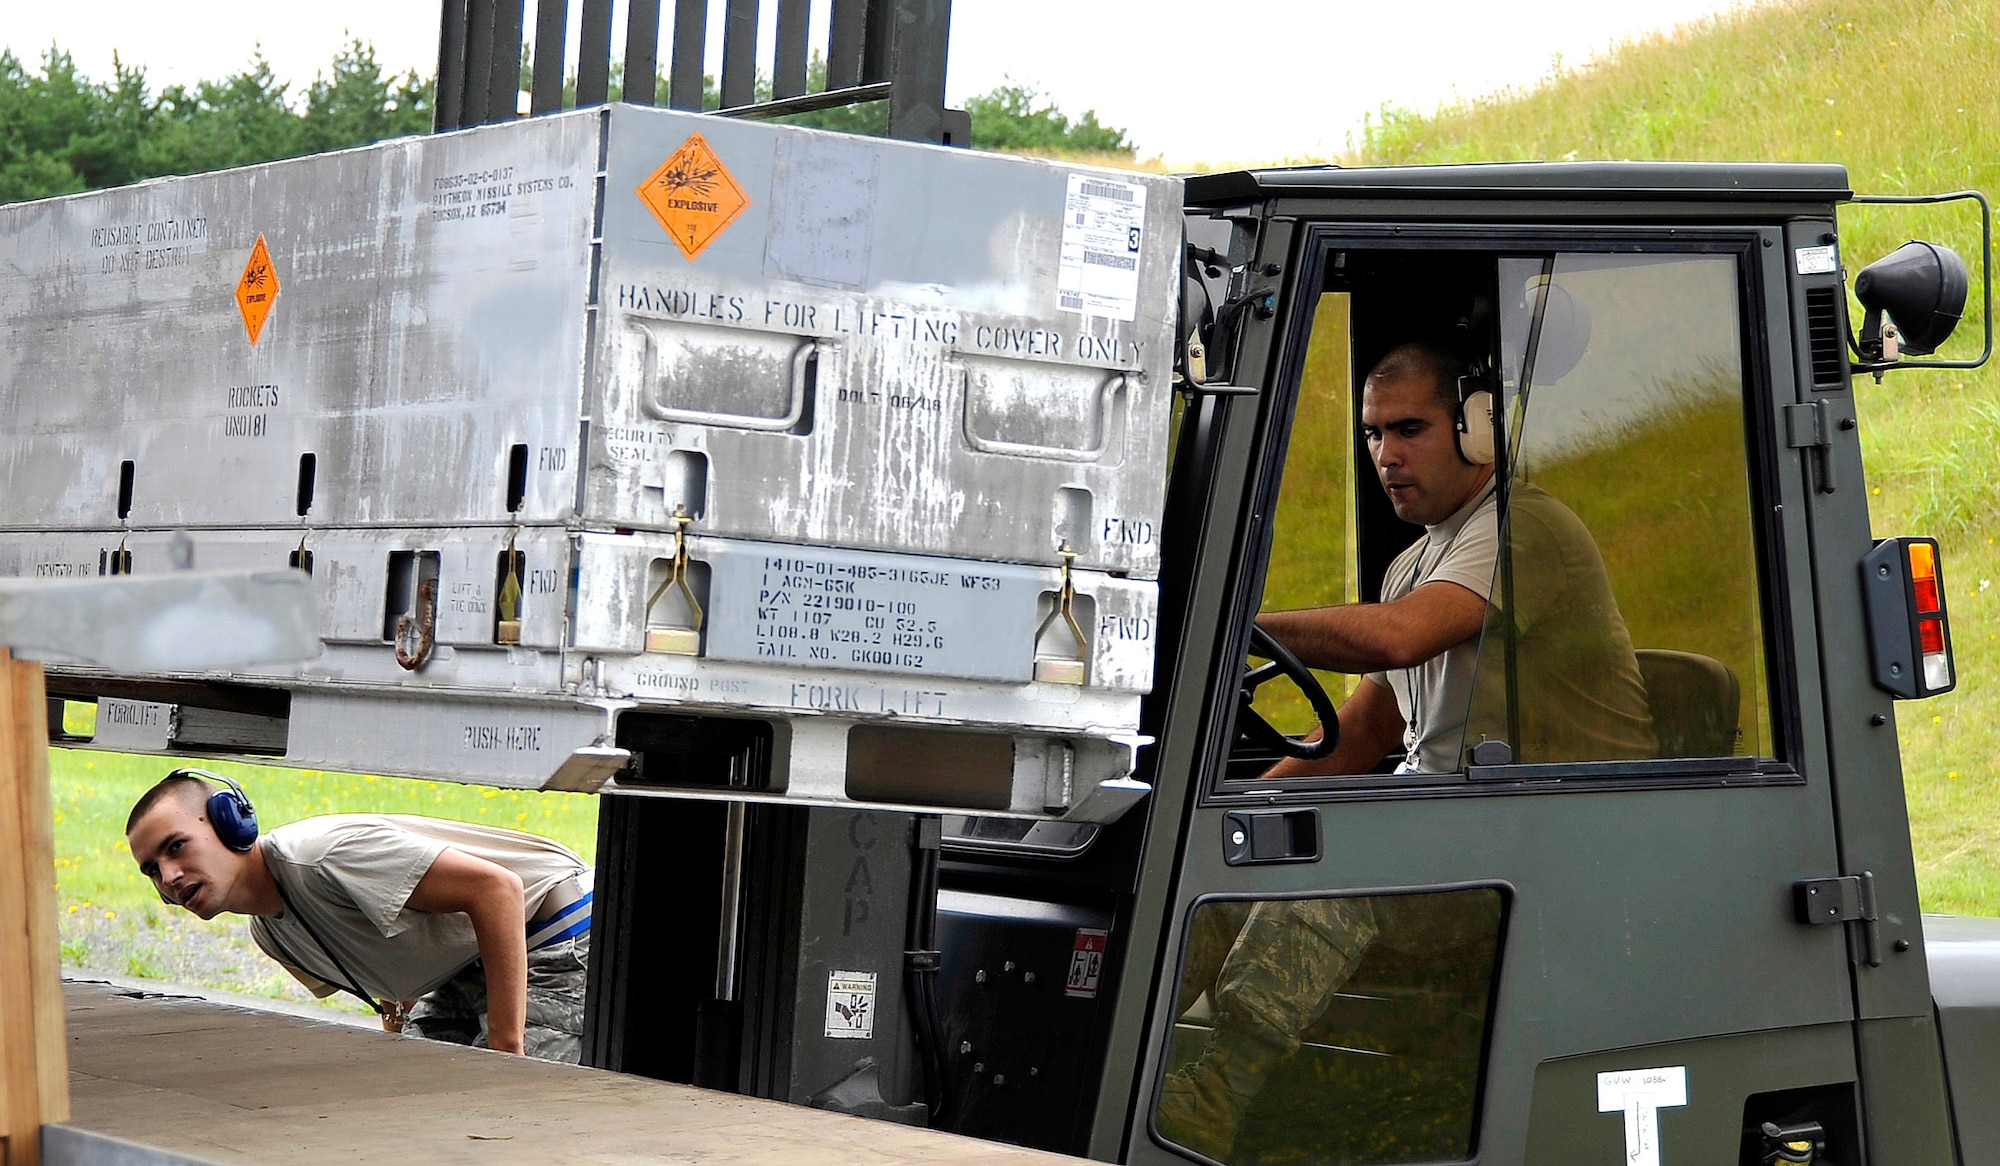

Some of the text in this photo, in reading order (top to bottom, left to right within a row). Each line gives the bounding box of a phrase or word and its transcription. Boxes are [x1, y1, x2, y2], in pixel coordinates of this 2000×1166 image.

[433, 176, 574, 207] RAYTHEON MISSILE SYSTEMS CO.
[481, 200, 506, 217] 85734
[667, 198, 719, 212] EXPLOSIVE
[91, 217, 207, 248] REUSABLE CONTAINER
[689, 235, 694, 246] 1
[1129, 229, 1140, 249] 3
[102, 245, 192, 275] DO NOT DESTROY
[618, 284, 1146, 364] HANDLES FOR LIFTING COVER ONLY
[228, 385, 279, 409] ROCKETS
[225, 413, 266, 437] UN0181
[603, 427, 675, 446] ECURITY
[539, 446, 566, 471] FWD
[610, 446, 651, 462] SEAL
[1103, 518, 1152, 544] FWD
[530, 570, 557, 594] FWD
[781, 574, 856, 594] AGM-65K
[961, 574, 1001, 591] WF53
[759, 590, 916, 616] P/N 2219010-100
[758, 606, 937, 633] WT 1107 CU 52.5
[1101, 616, 1150, 641] FWD
[756, 623, 820, 641] L108.8
[830, 628, 882, 646] W28.2
[757, 641, 924, 669] TAIL NO. GK00162
[637, 672, 750, 694] GROUND POST
[791, 683, 947, 717] FORK LIFT
[107, 702, 160, 726] FORKLIFT
[465, 726, 541, 751] PUSH HERE
[841, 981, 873, 992] WARNING
